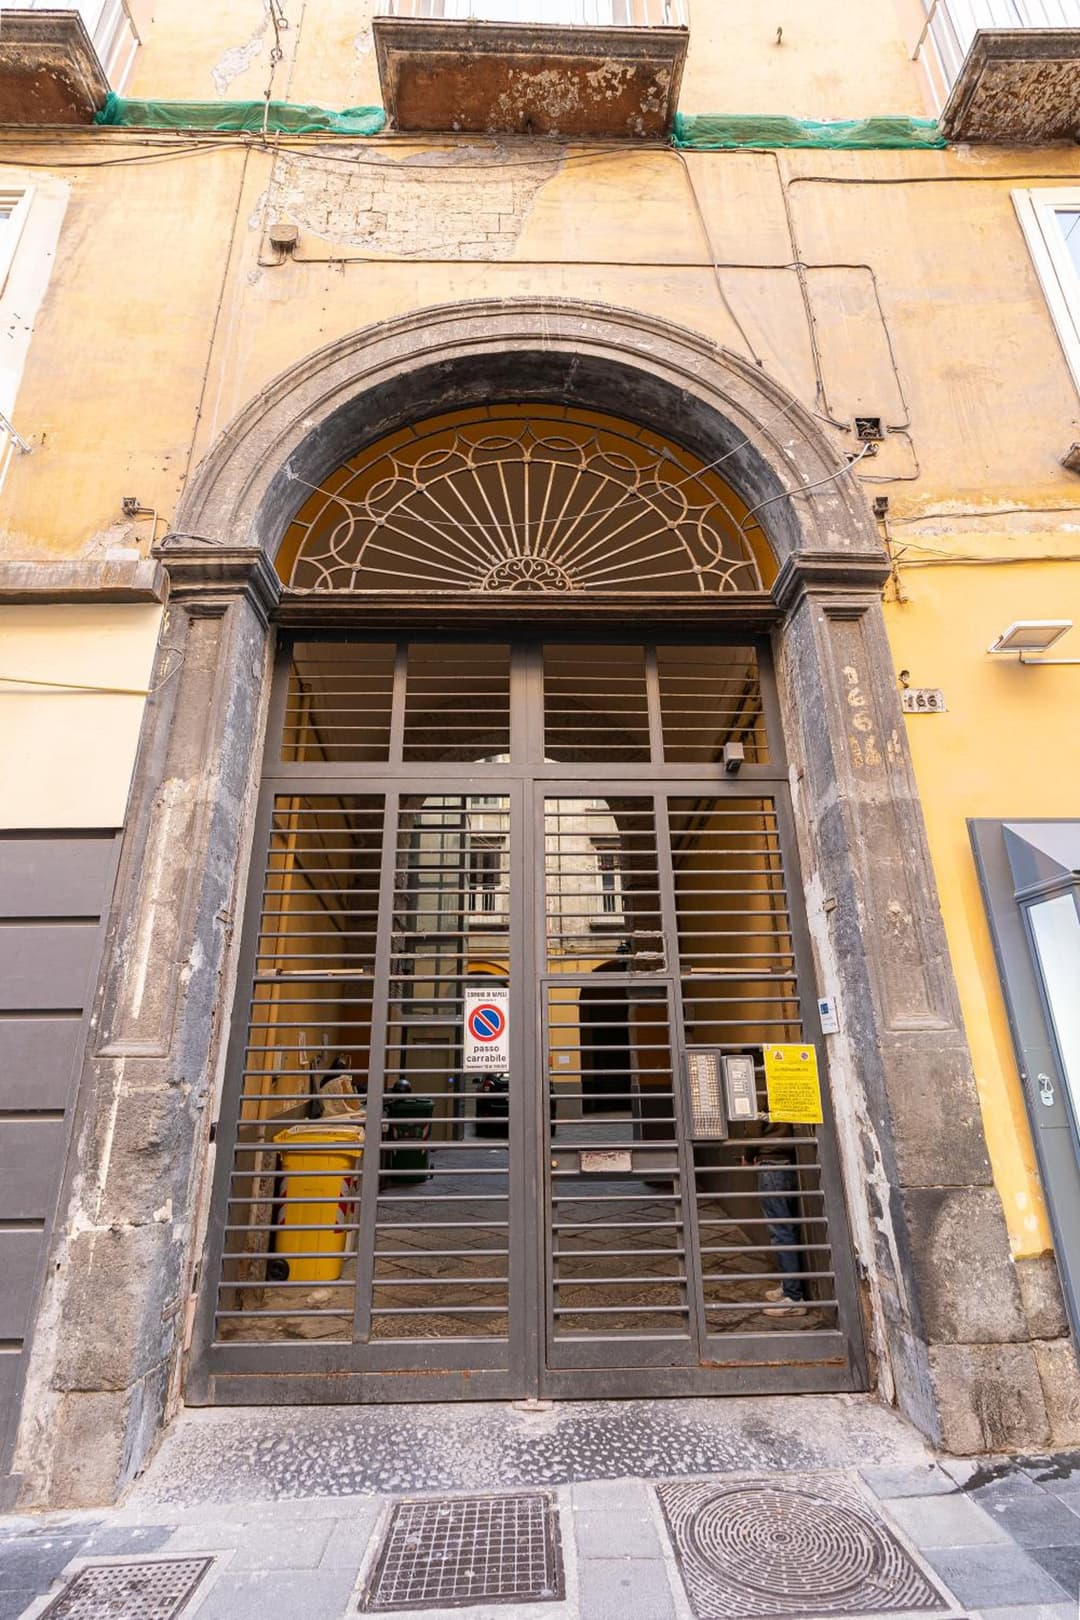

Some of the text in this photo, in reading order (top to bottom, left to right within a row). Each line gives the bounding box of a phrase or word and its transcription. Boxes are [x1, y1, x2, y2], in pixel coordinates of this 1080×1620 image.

[907, 695, 937, 707] 166
[473, 1045, 499, 1054] passo
[466, 1054, 506, 1062] carrabile
